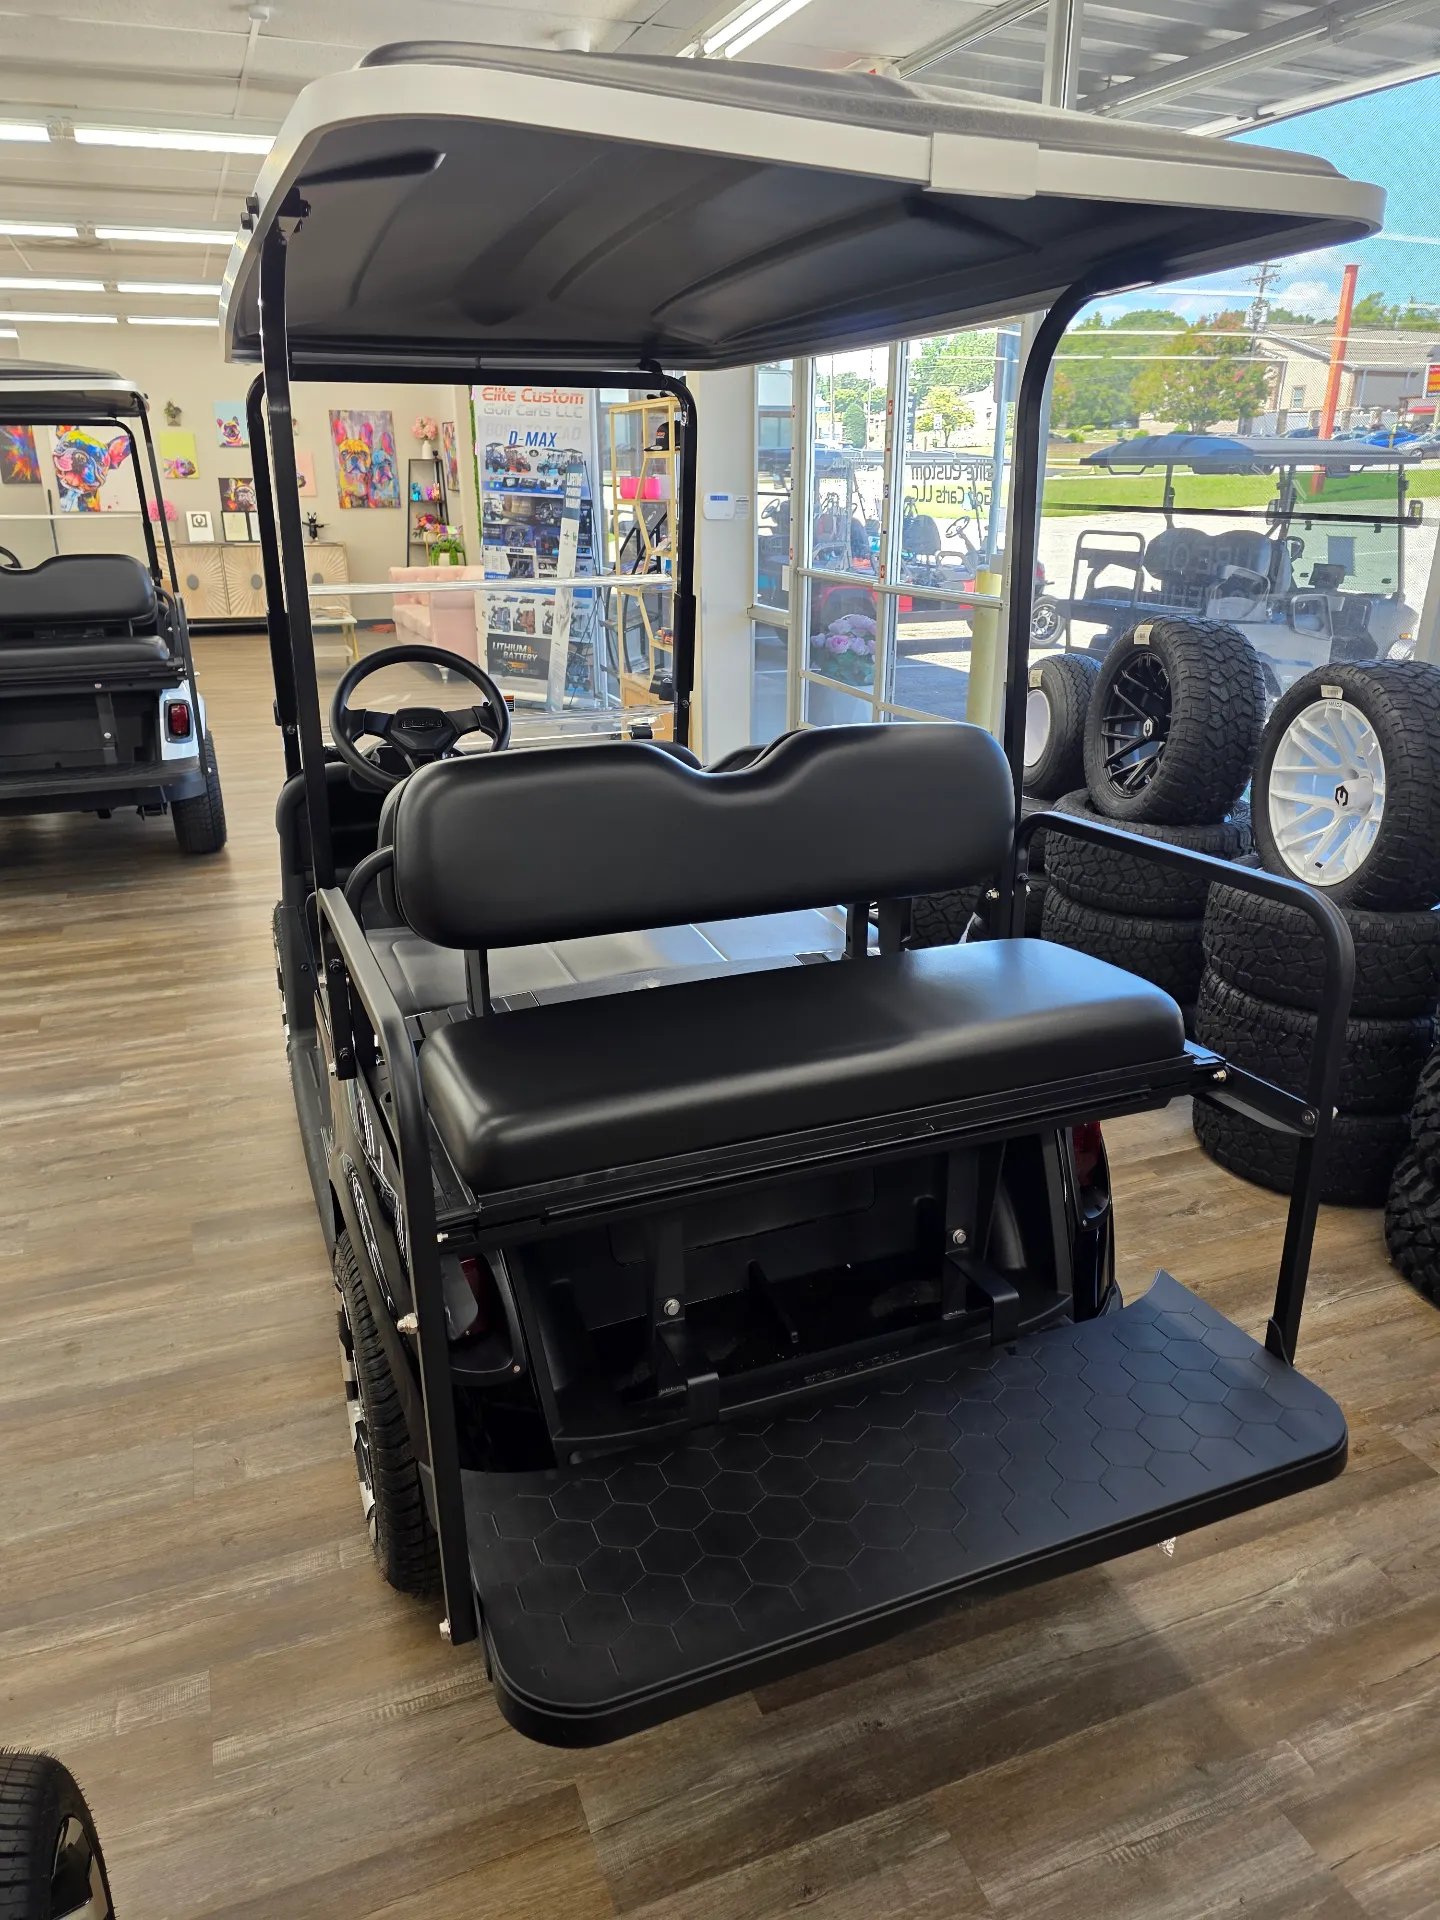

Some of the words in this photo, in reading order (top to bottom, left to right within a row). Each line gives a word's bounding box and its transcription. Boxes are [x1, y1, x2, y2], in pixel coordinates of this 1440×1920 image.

[482, 387, 516, 402] Elite
[521, 388, 584, 405] Custom
[556, 405, 583, 418] LLC
[508, 430, 558, 448] D-MAX
[492, 641, 528, 653] LITHIUM
[503, 651, 538, 662] BATTERY
